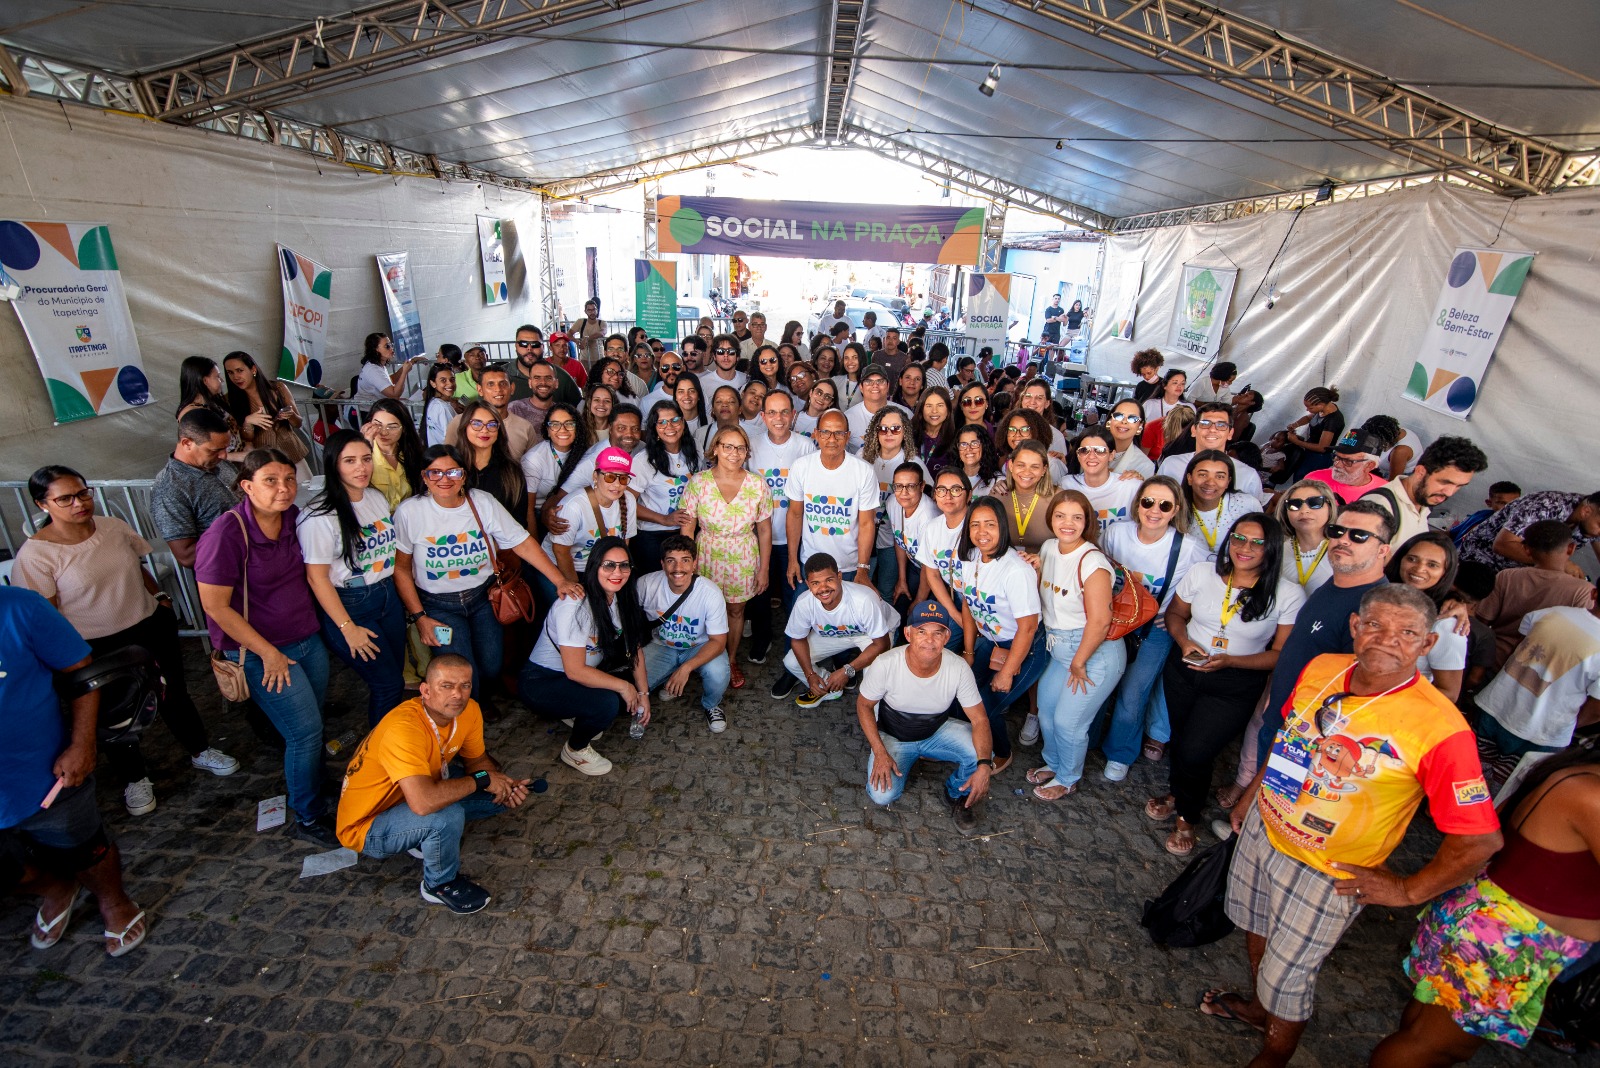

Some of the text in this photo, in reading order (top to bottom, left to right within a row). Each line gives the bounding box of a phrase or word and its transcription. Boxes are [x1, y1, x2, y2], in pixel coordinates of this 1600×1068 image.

[706, 216, 943, 249] SOCIAL NA PRAÇA
[24, 284, 109, 294] Procuradoria Geral
[38, 298, 50, 306] do
[95, 296, 105, 304] de
[53, 308, 99, 318] Itapetinga
[970, 315, 1004, 323] SOCIAL
[1448, 307, 1480, 323] Beleza
[1443, 320, 1494, 340] Bem-Estar
[69, 343, 107, 354] ITAPETINGA
[805, 502, 851, 517] SOCIAL
[806, 514, 851, 526] NA PRAÇA
[426, 540, 487, 559] SOCIAL
[425, 552, 489, 569] NA PRAÇA
